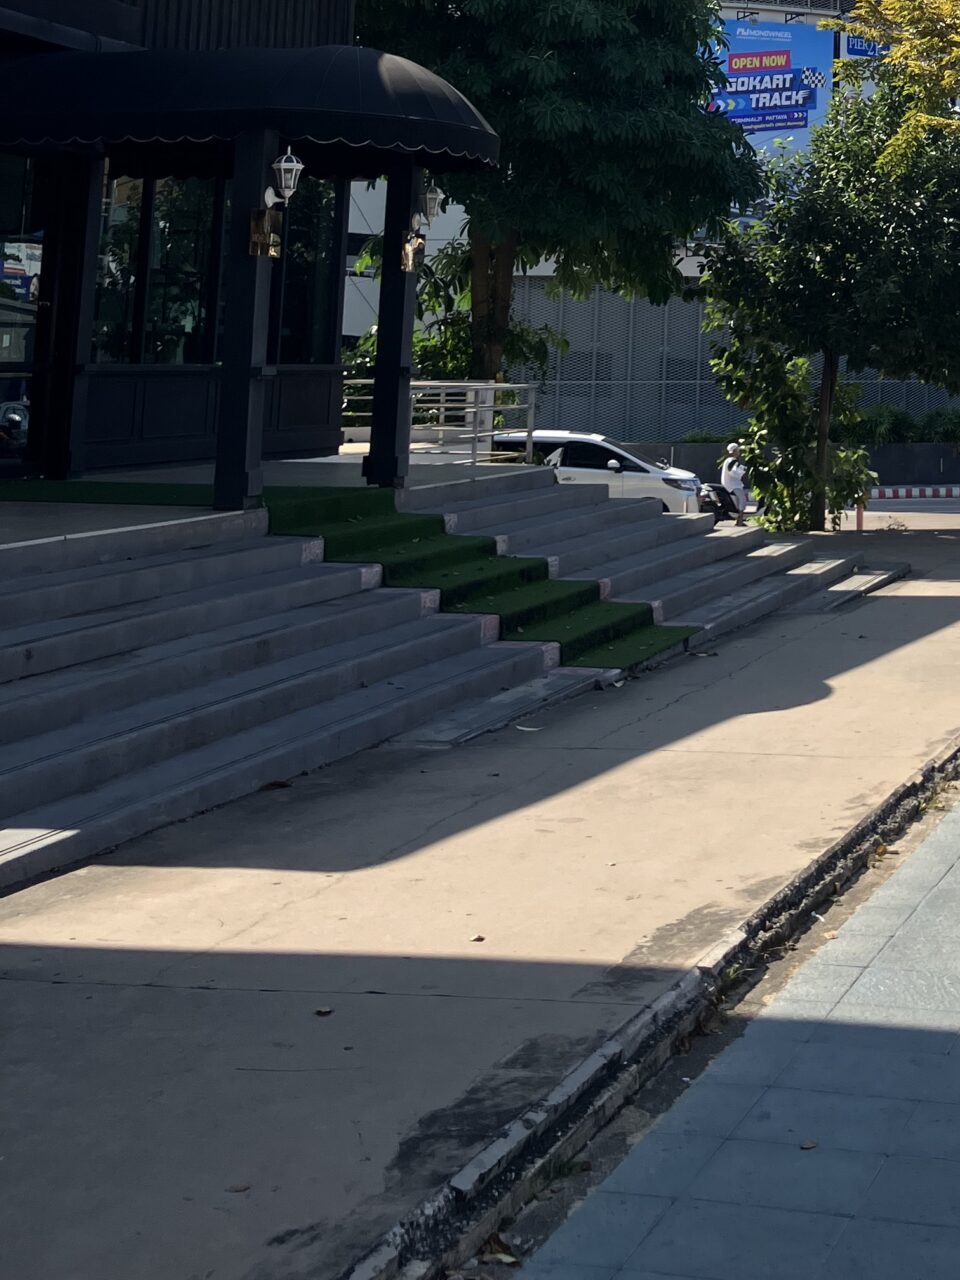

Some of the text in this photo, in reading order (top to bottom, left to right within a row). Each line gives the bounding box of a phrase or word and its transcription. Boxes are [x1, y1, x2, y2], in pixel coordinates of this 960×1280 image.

[731, 54, 787, 69] OPEN NOW
[749, 89, 808, 108] TRACK
